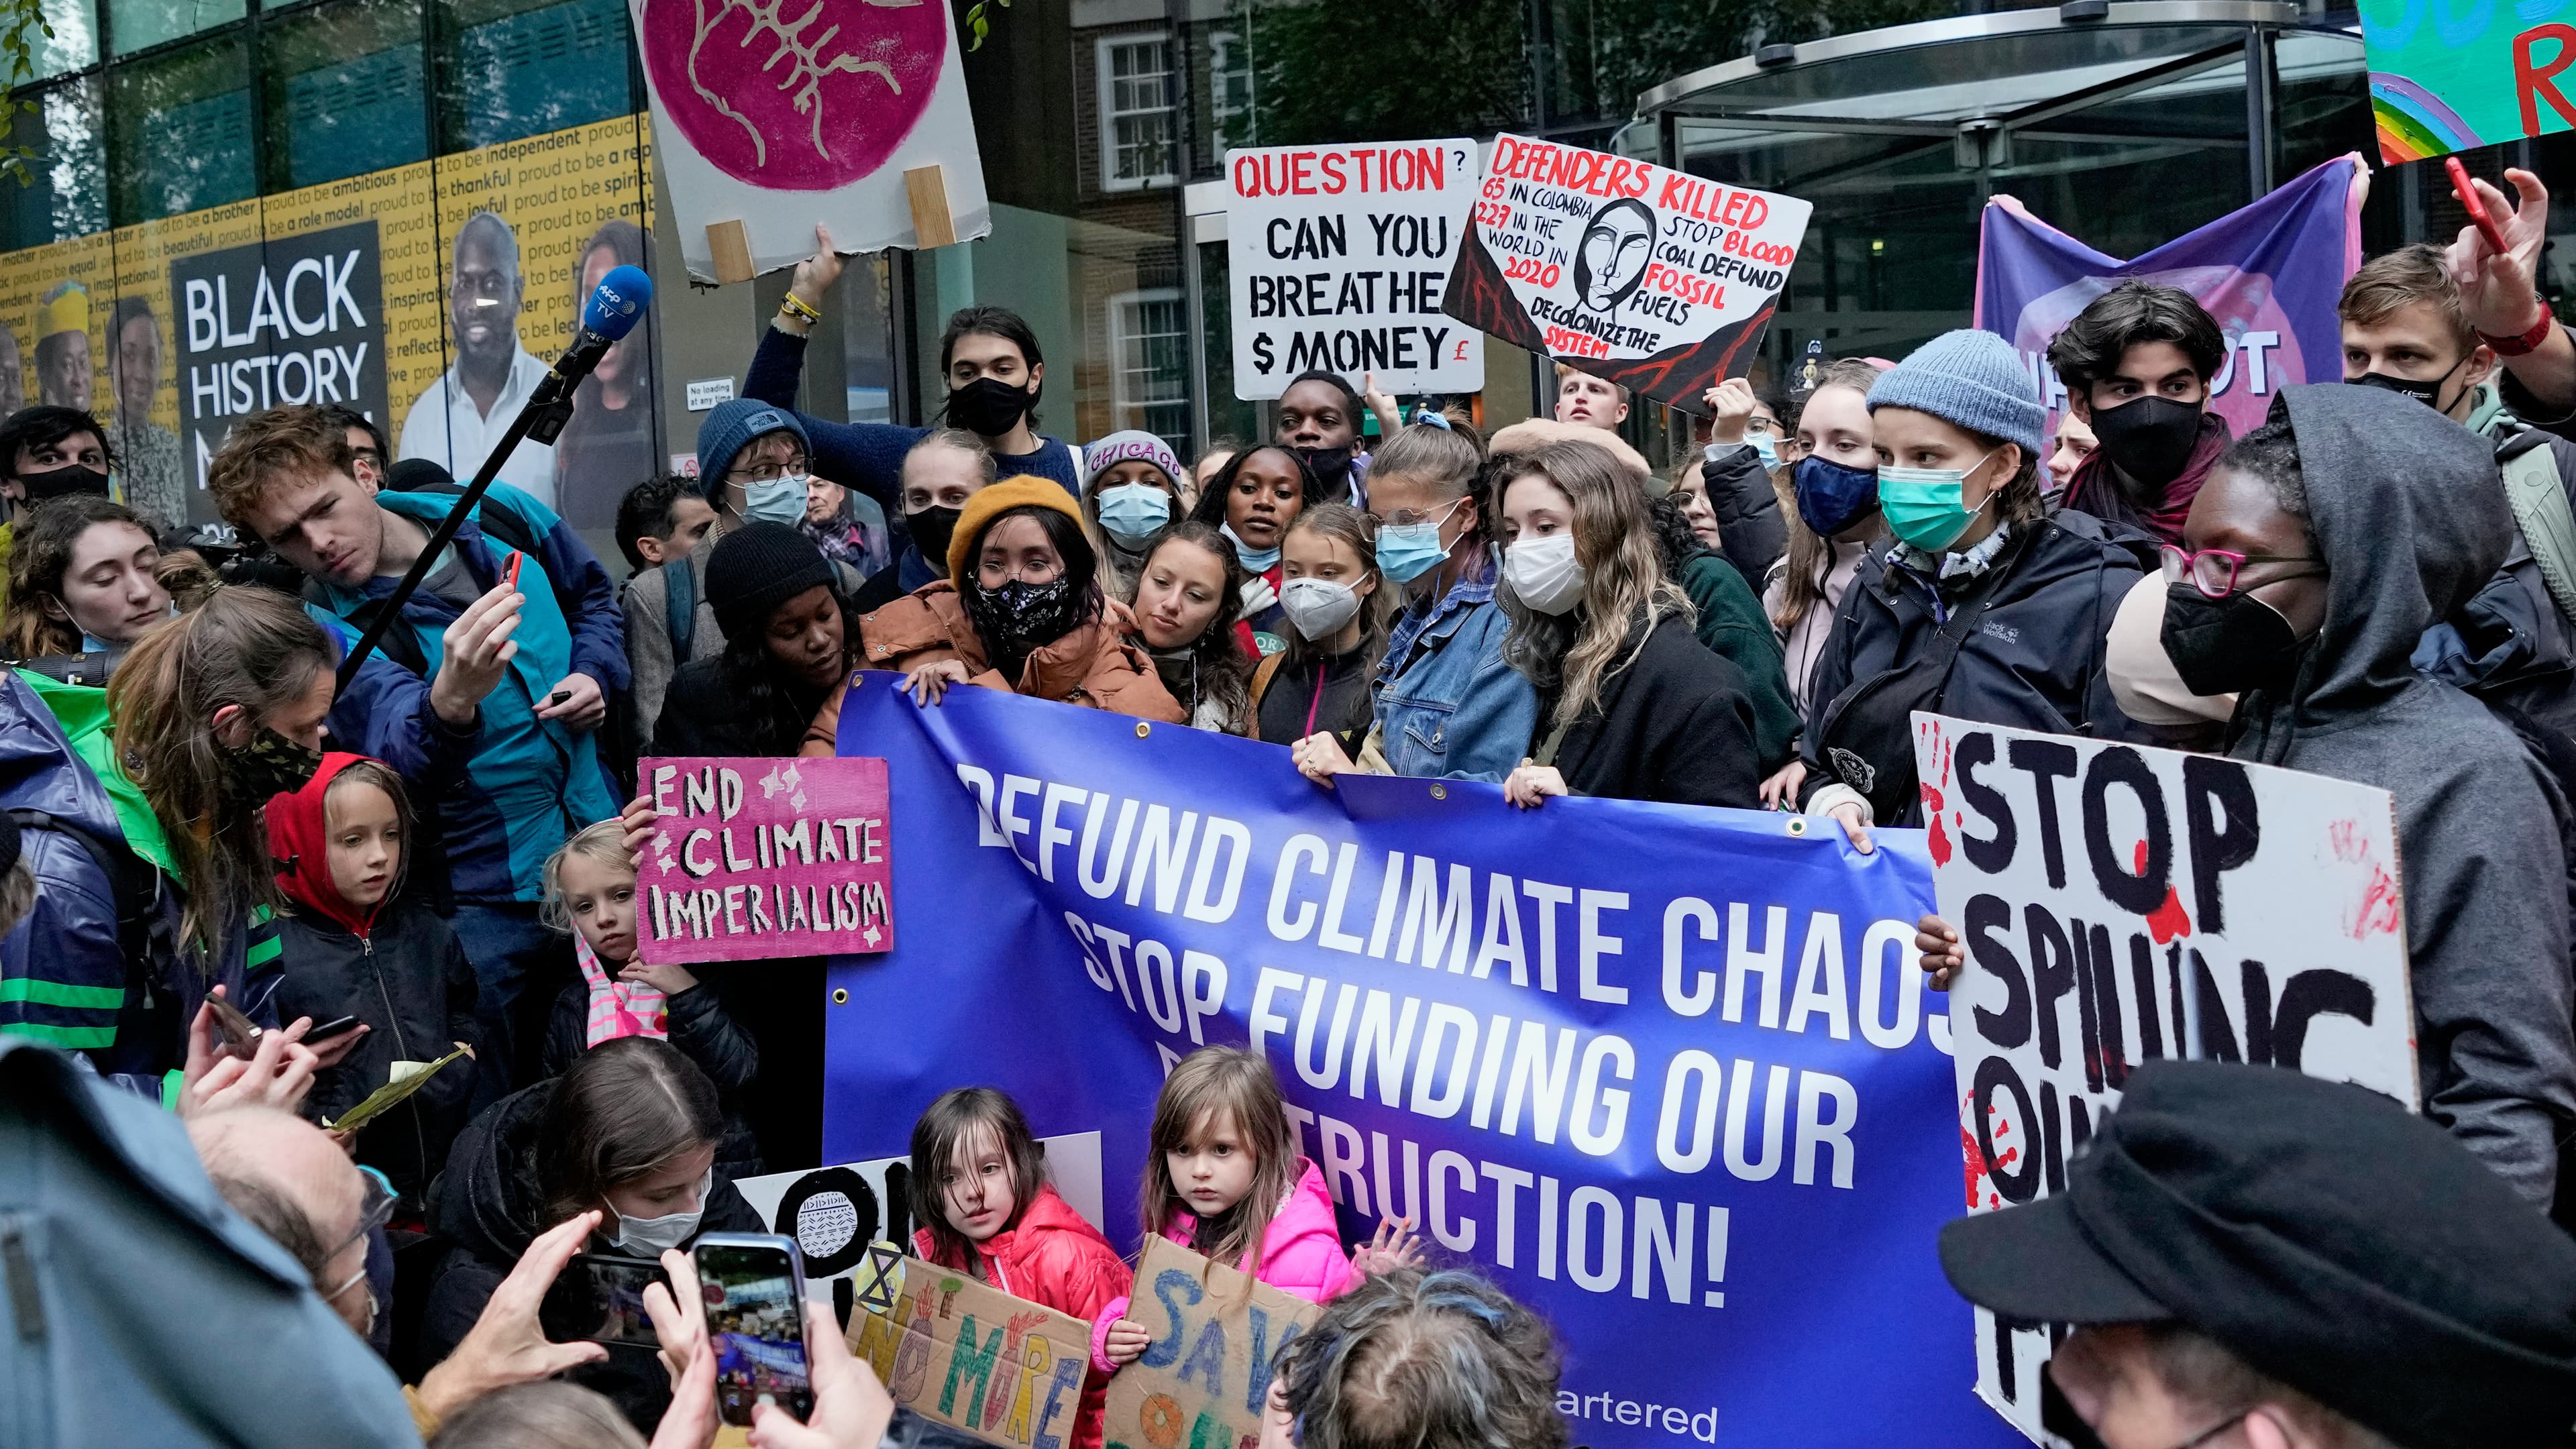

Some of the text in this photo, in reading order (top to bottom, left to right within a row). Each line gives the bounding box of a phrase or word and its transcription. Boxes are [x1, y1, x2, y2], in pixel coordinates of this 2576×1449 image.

[40, 245, 66, 263] proud
[69, 242, 80, 253] to
[83, 237, 95, 251] be
[97, 237, 103, 247] a
[106, 231, 134, 246] sster
[139, 222, 168, 243] proud
[172, 217, 183, 232] to
[186, 213, 200, 228] be
[202, 213, 210, 225] a
[212, 203, 256, 223] brother
[262, 191, 295, 213] proud
[299, 188, 311, 203] to
[314, 185, 330, 202] be
[333, 171, 397, 197] ambitious
[402, 162, 443, 188] proud
[447, 157, 462, 172] to
[465, 150, 482, 168] be
[486, 129, 582, 164] independent
[588, 115, 634, 148] proud
[1234, 146, 1444, 198] QUESTION
[1492, 138, 1769, 231] DEFENDERS KILLED
[13, 270, 40, 286] proud
[42, 268, 53, 281] to
[54, 264, 67, 277] be
[68, 256, 97, 276] equal
[134, 249, 145, 262] to
[148, 246, 161, 258] be
[163, 230, 213, 256] beautiful
[218, 225, 252, 248] proud
[254, 223, 266, 238] to
[270, 220, 284, 235] be
[287, 219, 295, 231] a
[299, 209, 321, 227] role
[325, 199, 364, 224] model
[370, 193, 408, 217] proud
[411, 190, 425, 206] to
[429, 181, 447, 201] be
[450, 167, 511, 197] thankful
[519, 157, 561, 189] proud
[566, 157, 582, 174] to
[585, 151, 605, 169] be
[609, 151, 619, 164] a
[1476, 201, 1563, 240] 227 IN THE
[1482, 177, 1593, 221] 65 IN COLOMBIA
[93, 264, 160, 292] insprational
[386, 212, 425, 240] proud
[427, 211, 443, 227] to
[447, 205, 465, 224] be
[467, 195, 508, 219] joyful
[515, 184, 557, 215] proud
[561, 185, 577, 201] to
[581, 178, 601, 197] be
[605, 168, 654, 198] spiritu
[415, 240, 429, 256] to
[432, 235, 451, 252] be
[528, 210, 571, 238] proud
[576, 209, 592, 225] to
[596, 203, 615, 221] be
[1267, 213, 1448, 260] CAN YOU
[1489, 228, 1568, 266] WORLD IN
[1662, 216, 1794, 266] STOP BLOOD
[416, 265, 430, 280] to
[433, 259, 452, 276] be
[528, 239, 571, 266] proud
[1503, 256, 1560, 289] 2020
[1656, 241, 1784, 292] COAL DEFUND
[186, 249, 368, 354] BLACK
[390, 284, 452, 309] inspirati
[530, 271, 545, 286] to
[549, 265, 569, 282] be
[597, 302, 615, 319] TV
[599, 285, 621, 303] AFP
[1250, 270, 1446, 318] BREATHE
[1629, 290, 1692, 327] FUELS
[1644, 263, 1726, 310] FOSSIL
[396, 334, 458, 358] reflectiv
[531, 320, 550, 339] be
[398, 315, 437, 337] proud
[1531, 296, 1661, 354] DECOLONIZE THE
[1543, 325, 1610, 360] SYSTEM
[1286, 326, 1450, 374] MONEY
[191, 341, 370, 420] HISTORY
[690, 383, 731, 396] No loading
[690, 394, 732, 407] at any time
[1091, 441, 1181, 476] CHICAGO
[1983, 626, 2017, 645] Wolfskin
[1985, 620, 2006, 632] Jack
[650, 763, 744, 823] END
[679, 817, 883, 879] CLIMATE
[1954, 731, 2260, 934] STOP
[957, 763, 1252, 924] DEFUND
[1266, 833, 1630, 1006] CLIMATE
[648, 881, 890, 941] IMPERIALISM
[1064, 910, 1229, 1046] STOP
[1248, 966, 1636, 1157] FUNDING
[1656, 1050, 1860, 1190] OUR
[1155, 1040, 1731, 1309] TRUCTION!
[1139, 1267, 1303, 1418] SAV
[855, 1293, 933, 1403] NO
[937, 1313, 1084, 1449] MORE
[1555, 1389, 1719, 1445] artered
